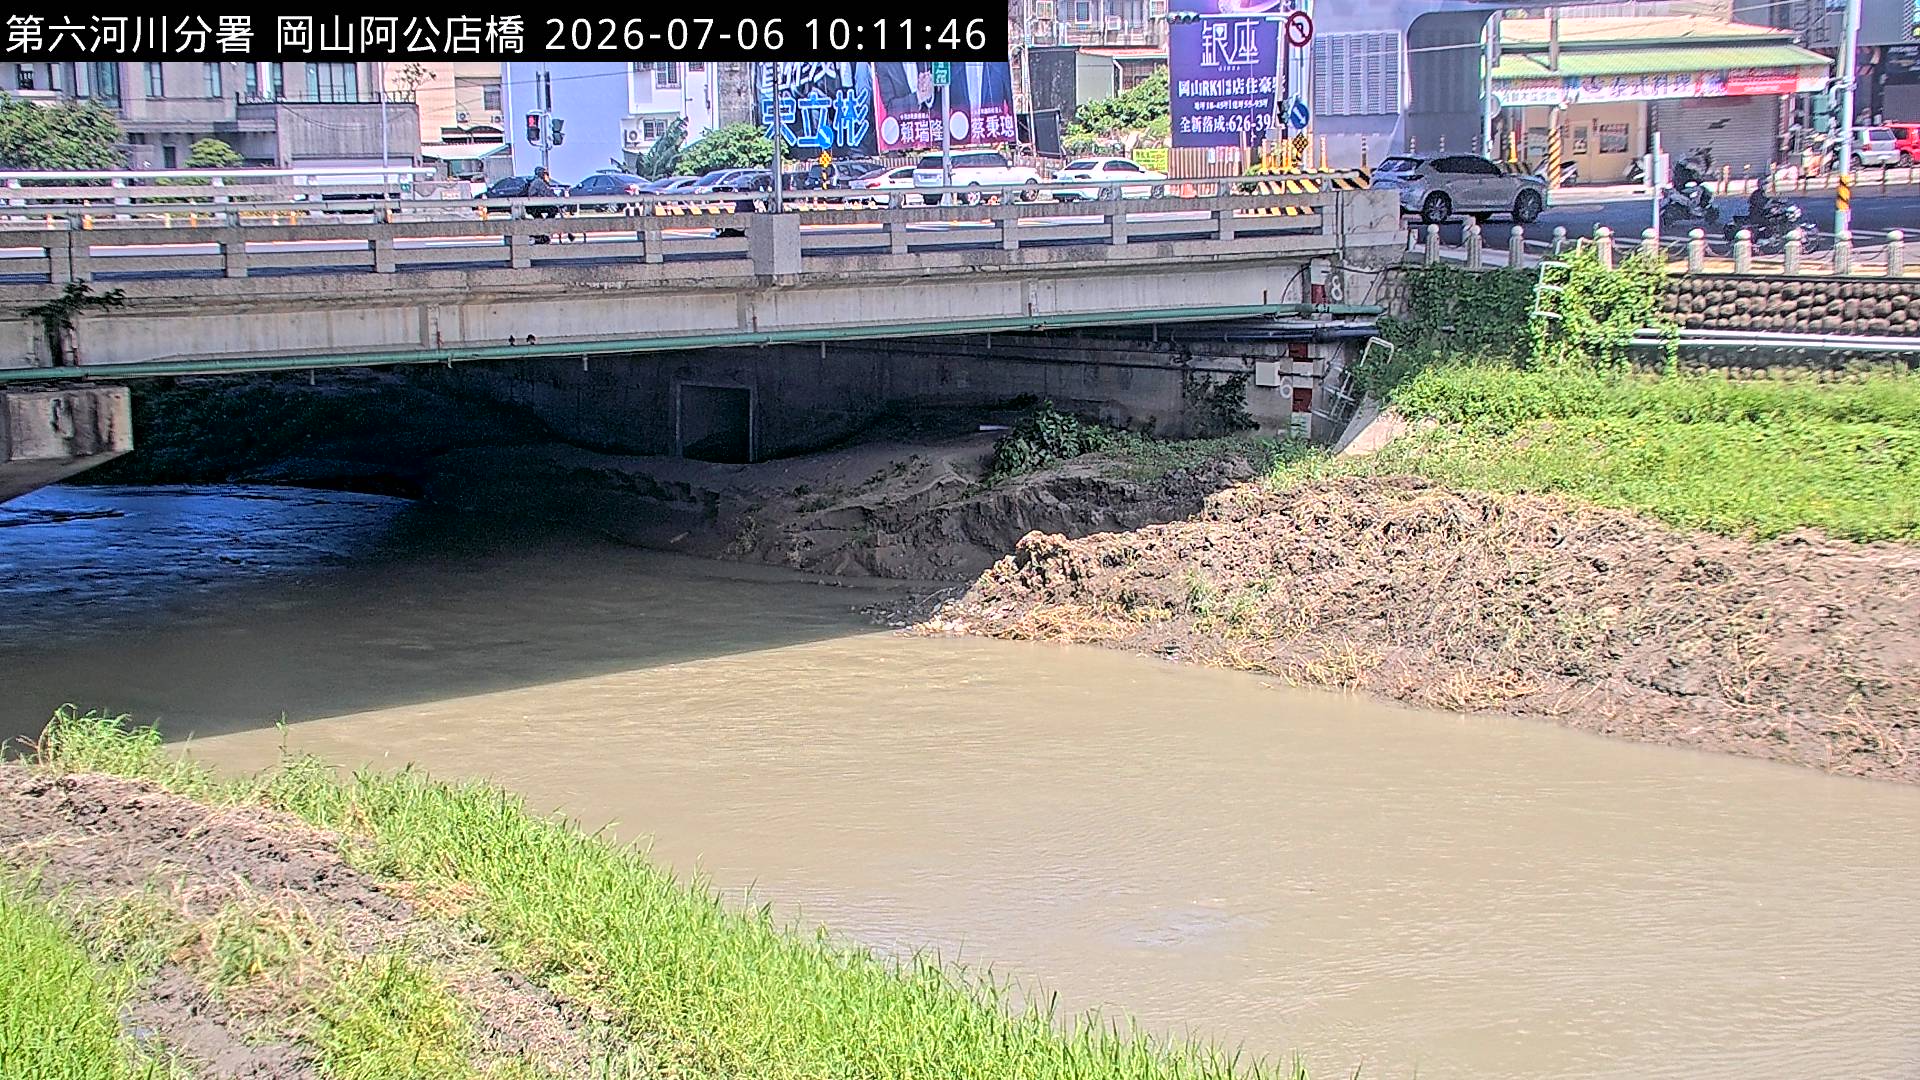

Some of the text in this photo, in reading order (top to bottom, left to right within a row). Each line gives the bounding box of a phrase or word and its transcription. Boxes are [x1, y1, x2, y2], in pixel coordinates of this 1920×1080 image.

[1200, 18, 1260, 67] 銀座
[900, 119, 943, 143] 賴瑞隆
[1331, 275, 1343, 301] 8
